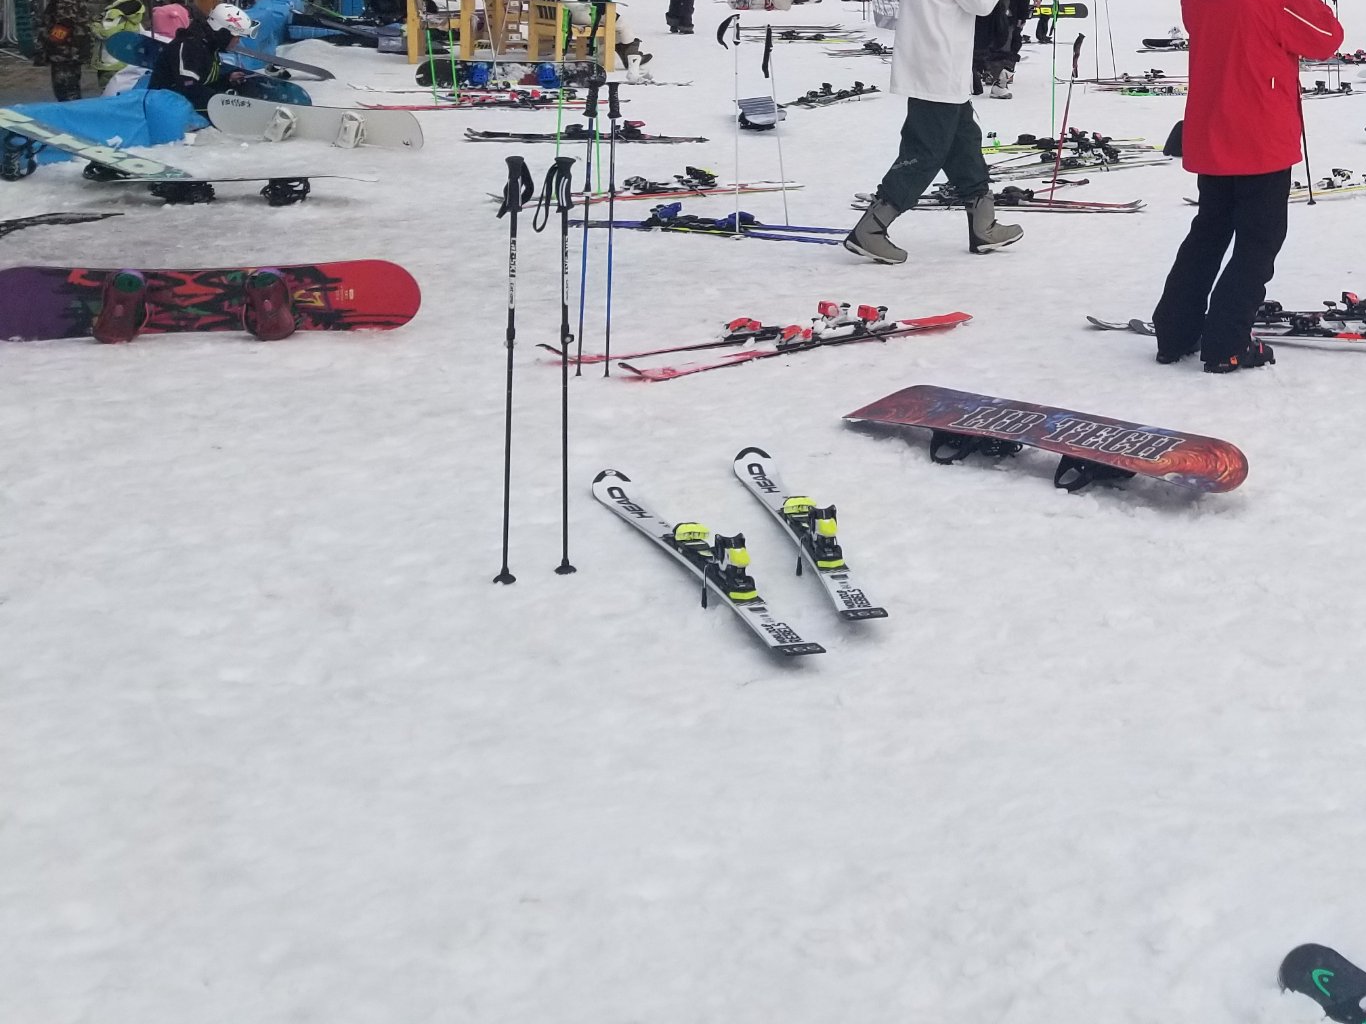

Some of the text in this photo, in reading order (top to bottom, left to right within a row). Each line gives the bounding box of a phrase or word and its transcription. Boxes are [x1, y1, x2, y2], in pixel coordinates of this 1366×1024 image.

[948, 406, 1186, 462] LIB TECH
[747, 463, 781, 494] HEAD
[607, 486, 654, 519] HEAD
